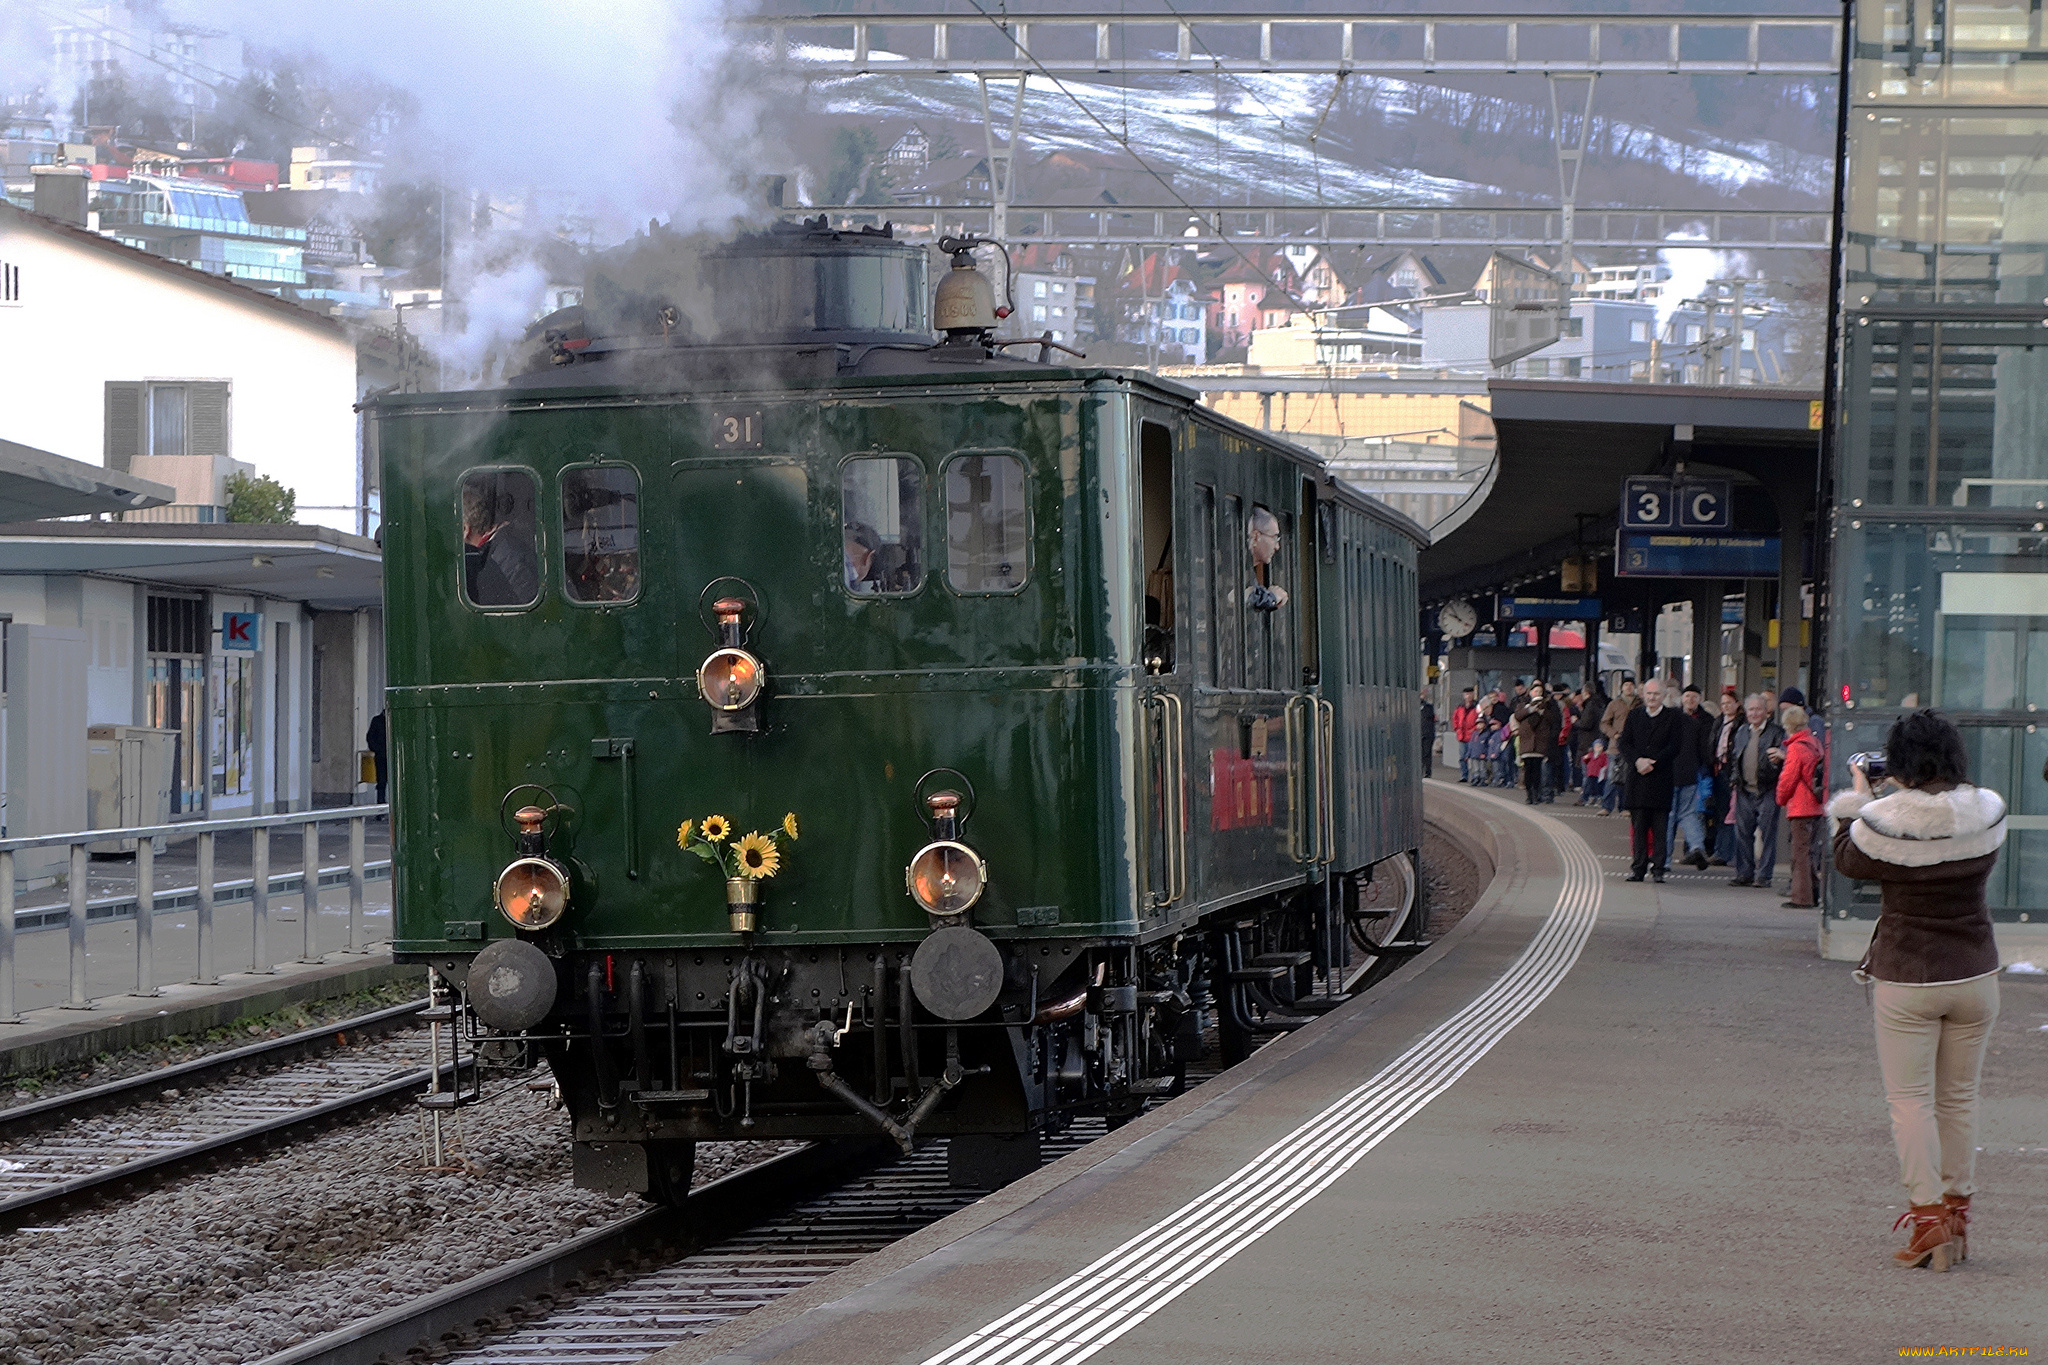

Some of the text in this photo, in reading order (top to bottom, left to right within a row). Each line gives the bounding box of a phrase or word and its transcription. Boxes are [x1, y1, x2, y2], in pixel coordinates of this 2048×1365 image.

[723, 417, 751, 442] 31
[1637, 493, 1660, 522] 3
[1692, 493, 1717, 522] C
[1632, 554, 1642, 566] 3
[1615, 618, 1624, 629] B
